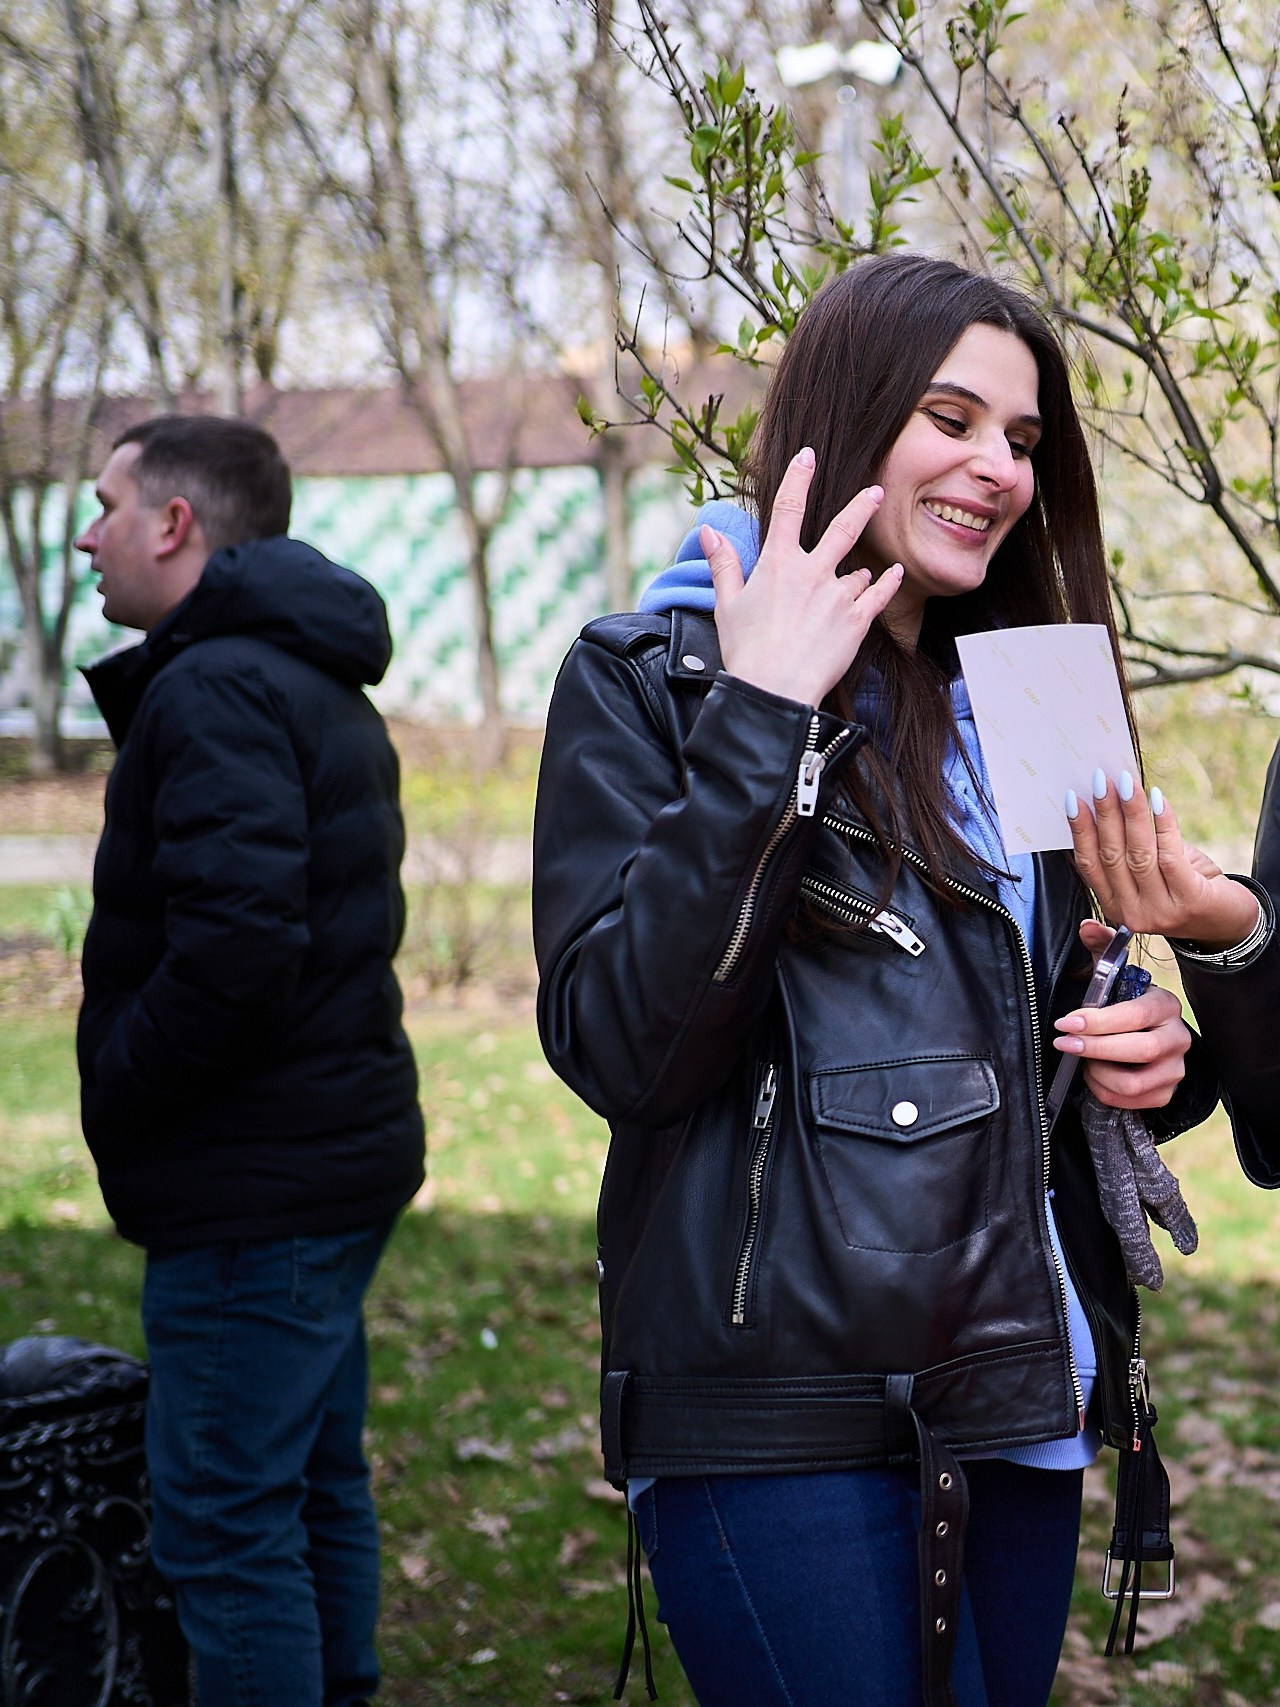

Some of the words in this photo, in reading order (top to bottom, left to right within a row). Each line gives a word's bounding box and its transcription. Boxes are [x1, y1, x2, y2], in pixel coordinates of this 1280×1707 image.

[1023, 687, 1041, 706] DNP
[1096, 714, 1111, 734] DNP
[1019, 758, 1037, 777] DNP
[1015, 826, 1032, 844] DNP
